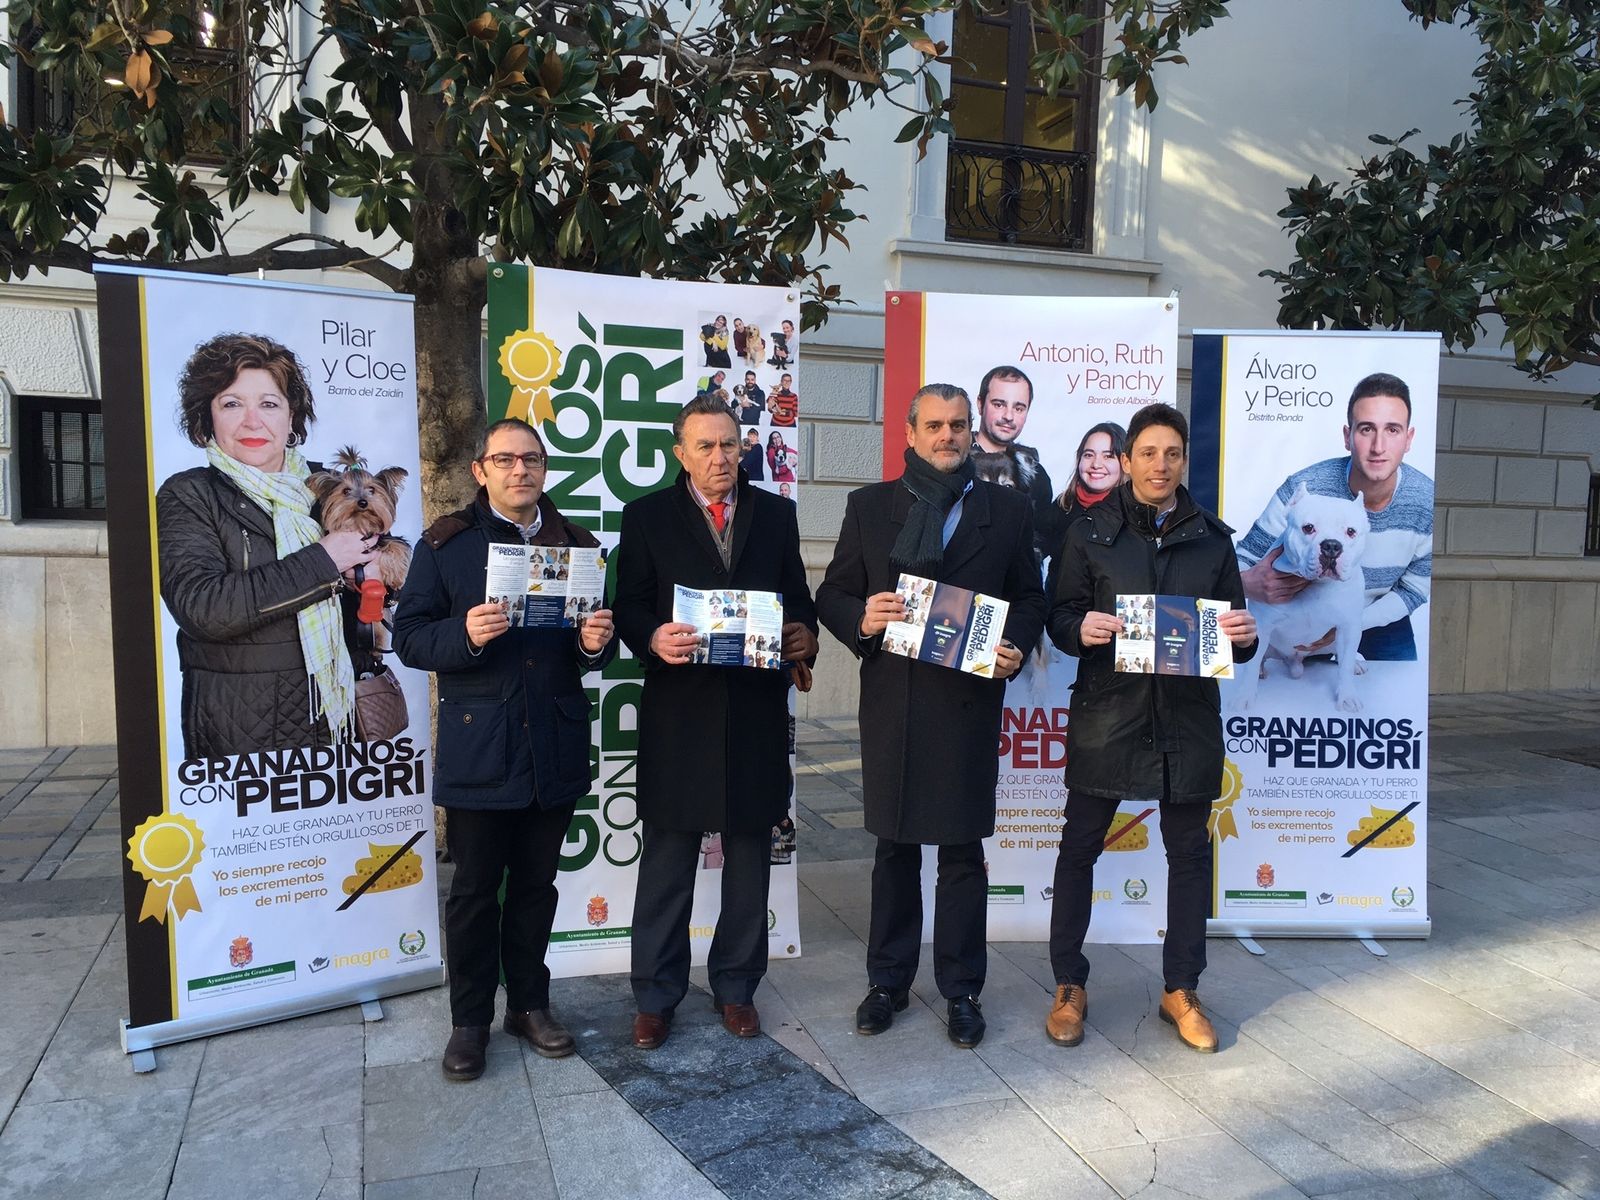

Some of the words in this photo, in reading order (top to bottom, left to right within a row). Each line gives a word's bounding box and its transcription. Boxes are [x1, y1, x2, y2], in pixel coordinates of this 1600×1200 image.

[322, 320, 376, 347] Pilar
[1020, 342, 1108, 366] Antonio,
[1116, 344, 1162, 364] Ruth
[322, 358, 338, 383] y
[346, 354, 406, 381] Cloe
[1246, 352, 1316, 380] Álvaro
[328, 385, 357, 396] Barrio
[359, 387, 373, 396] del
[1067, 374, 1080, 394] y
[1086, 369, 1164, 396] Panchy
[1088, 396, 1112, 404] Barrio
[1113, 396, 1125, 404] del
[1245, 390, 1258, 412] y
[1265, 386, 1333, 407] Perico
[1248, 413, 1275, 421] Distrito
[1276, 414, 1304, 422] Ronda
[1226, 716, 1414, 740] GRANADINOS
[1226, 738, 1267, 754] CON
[1268, 731, 1424, 770] PEDIGRÍ
[178, 737, 415, 786] GRANADINOS
[180, 780, 235, 806] CON
[236, 749, 426, 817] PEDIGRÍ
[1006, 774, 1030, 784] QUE
[1033, 774, 1065, 784] GRAN
[1264, 776, 1284, 786] HAZ
[1287, 777, 1308, 786] QUE
[1310, 777, 1360, 786] GRANADA
[1361, 778, 1368, 786] Y
[1370, 778, 1384, 786] TU
[1386, 778, 1418, 786] PERRO
[1012, 787, 1048, 800] ESTÉN
[1247, 787, 1290, 798] TAMBIÉN
[1292, 788, 1323, 799] ESTÉN
[1326, 790, 1392, 800] ORGULLOSOS
[1395, 791, 1407, 800] DE
[1409, 791, 1418, 800] TI
[232, 826, 260, 840] HAZ
[263, 822, 290, 836] QUE
[293, 814, 355, 832] GRANADA
[356, 812, 365, 824] Y
[366, 810, 382, 822] TU
[386, 804, 423, 818] PERRO
[1247, 807, 1260, 816] Yo
[1262, 808, 1302, 819] siempre
[1304, 808, 1336, 820] recojo
[994, 824, 1064, 833] xcrementos
[1252, 820, 1266, 830] los
[1268, 821, 1333, 830] excrementos
[210, 840, 268, 858] TAMBIÉN
[270, 834, 310, 850] ESTÉN
[312, 824, 394, 844] ORGULLOSOS
[397, 820, 413, 832] DE
[415, 818, 424, 829] TI
[1000, 838, 1014, 848] de
[1018, 838, 1033, 848] mi
[1036, 840, 1061, 851] perr
[1278, 833, 1292, 843] de
[1294, 834, 1306, 843] mi
[1308, 836, 1336, 846] perro
[212, 869, 229, 882] Yo
[232, 861, 285, 881] siempre
[288, 855, 327, 874] recojo
[219, 885, 239, 897] los
[241, 872, 324, 893] excrementos
[255, 894, 273, 907] de
[276, 890, 292, 904] mi
[294, 886, 328, 904] perro
[1337, 894, 1384, 908] inagra
[332, 946, 390, 968] inagra
[251, 968, 274, 976] Granada
